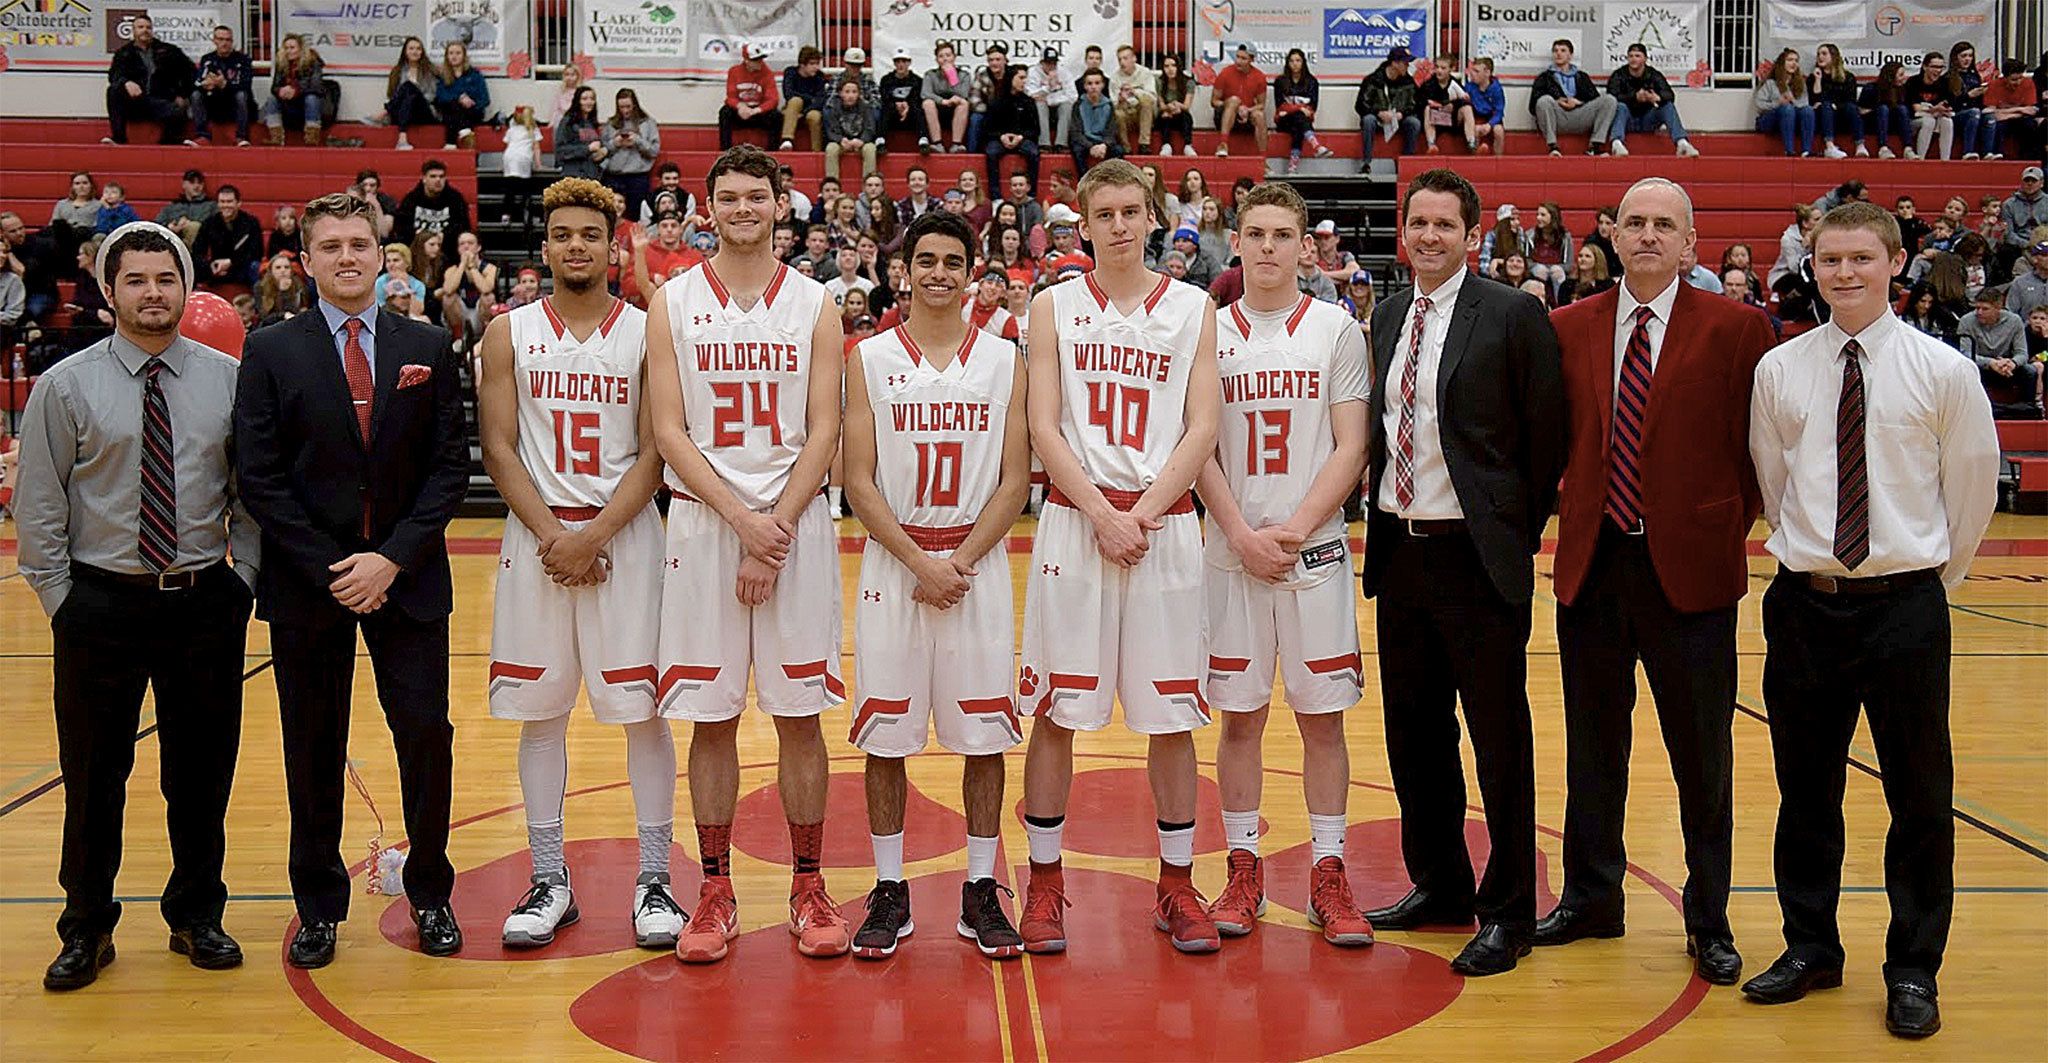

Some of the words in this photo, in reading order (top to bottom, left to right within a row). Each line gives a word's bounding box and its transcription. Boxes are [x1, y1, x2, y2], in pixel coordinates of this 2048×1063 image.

[0, 12, 92, 27] Oktoberfest
[154, 17, 206, 28] BROWN
[592, 11, 641, 24] LAKE
[931, 13, 1037, 31] MOUNT
[1048, 13, 1073, 32] SI
[589, 26, 682, 43] WASHINGTON
[1329, 34, 1363, 46] TWIN
[1364, 34, 1410, 47] PEAKS
[694, 342, 798, 371] WILDCATS
[1073, 343, 1171, 382] WILDCATS
[529, 371, 628, 404] WILDCATS
[1221, 370, 1319, 403] WILDCATS
[711, 382, 783, 447] 24
[891, 402, 989, 431] WILDCATS
[1087, 382, 1150, 452] 40
[551, 409, 600, 476] 15
[1243, 409, 1291, 475] 13
[914, 442, 962, 507] 10
